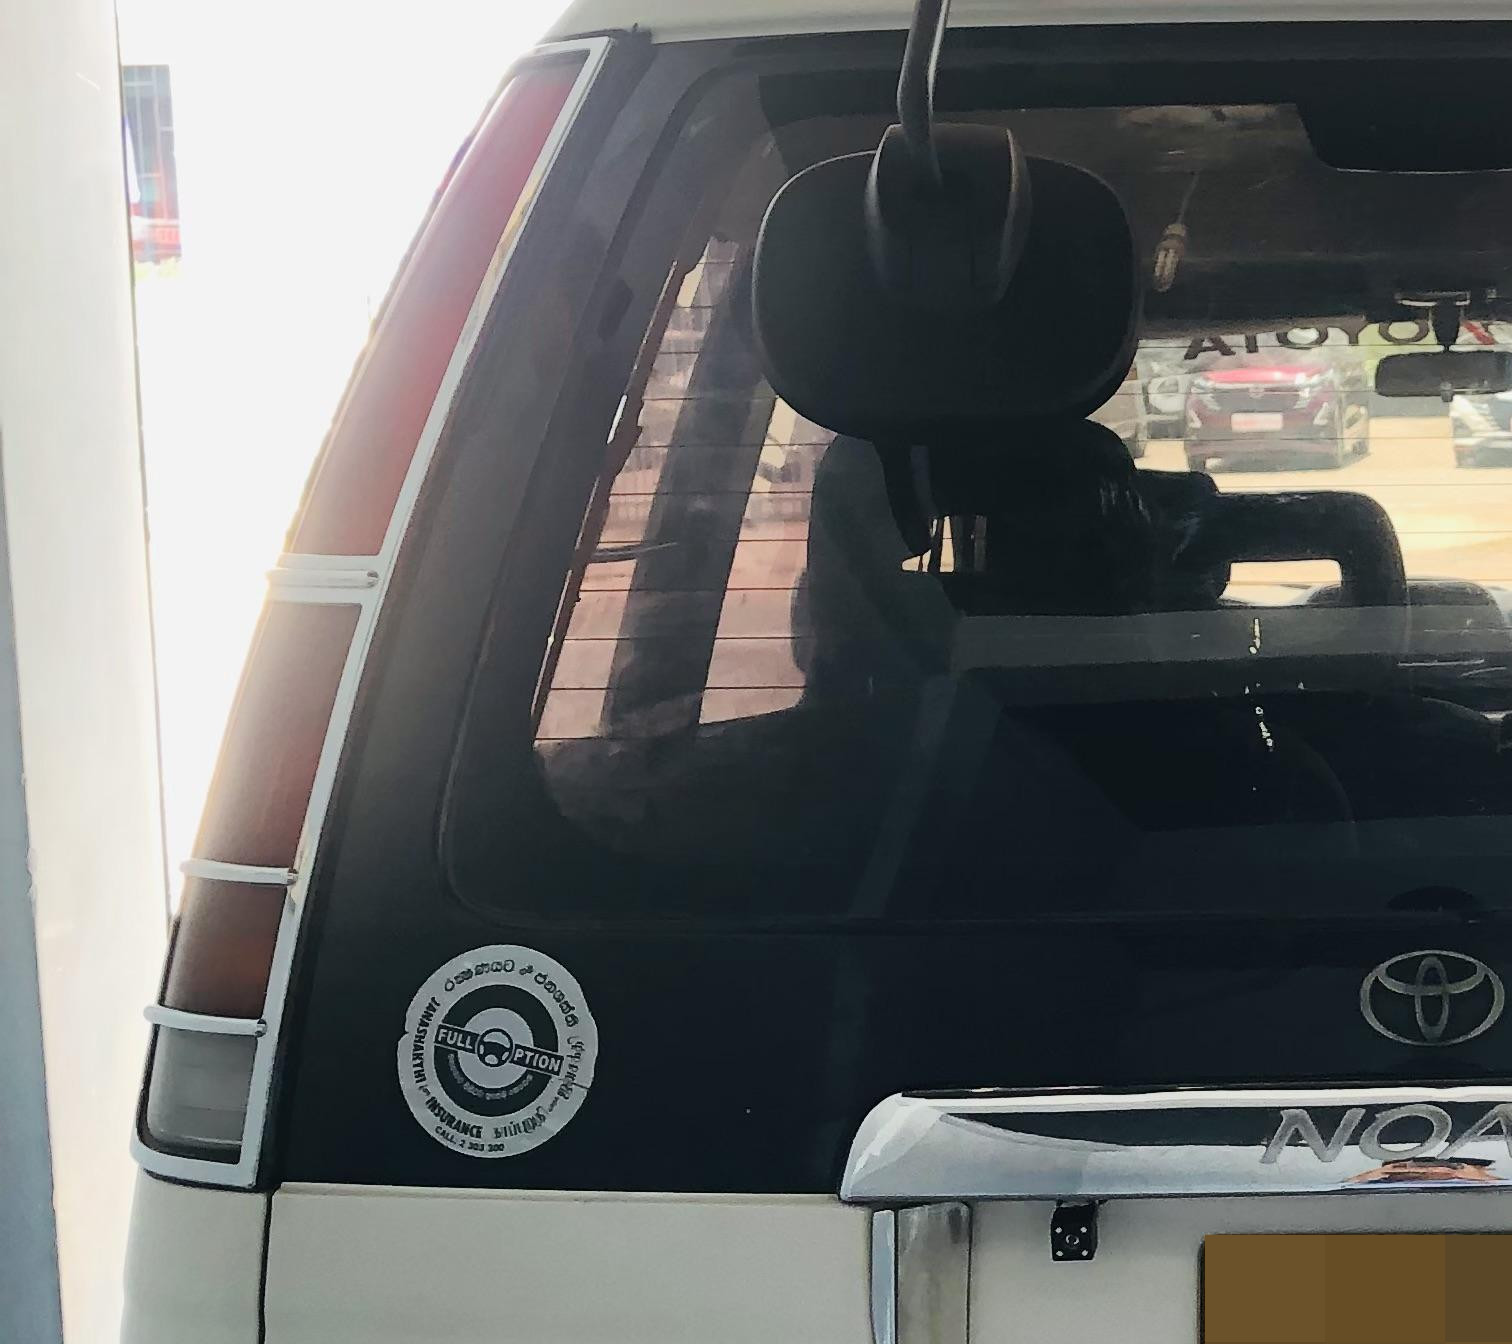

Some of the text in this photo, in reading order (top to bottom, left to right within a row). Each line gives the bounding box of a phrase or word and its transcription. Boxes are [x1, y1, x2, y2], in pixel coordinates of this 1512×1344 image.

[412, 996, 440, 1084] JANASHAKTHI
[438, 1028, 473, 1049] FULL
[425, 1096, 483, 1139] INSURANCE
